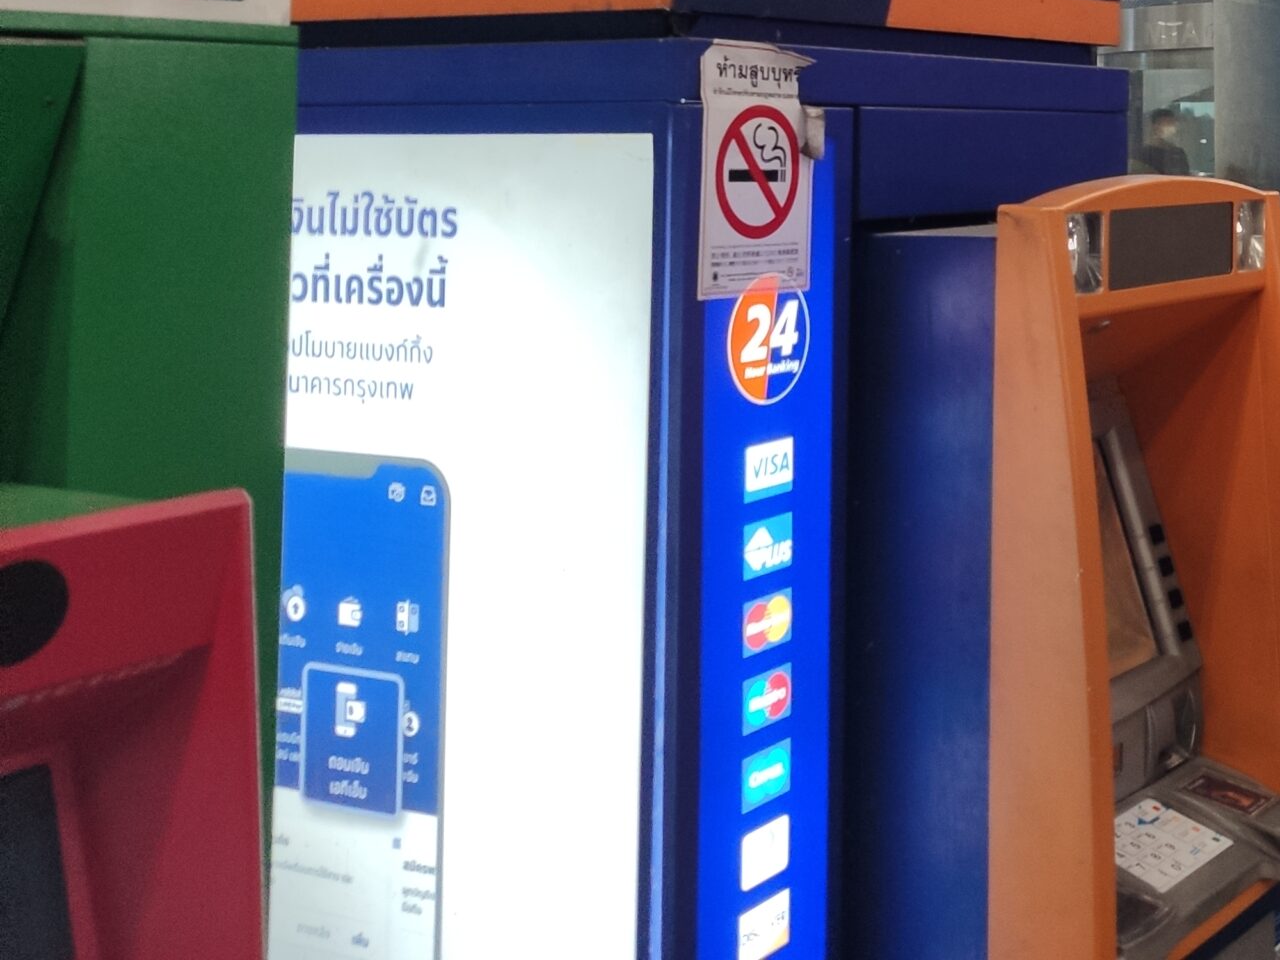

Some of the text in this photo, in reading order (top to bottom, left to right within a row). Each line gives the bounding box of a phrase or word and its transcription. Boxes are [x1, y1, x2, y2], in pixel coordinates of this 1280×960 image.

[287, 330, 434, 365] ปโมบายแบงก์กิ้ง
[739, 298, 800, 364] 24
[753, 451, 790, 480] VISA
